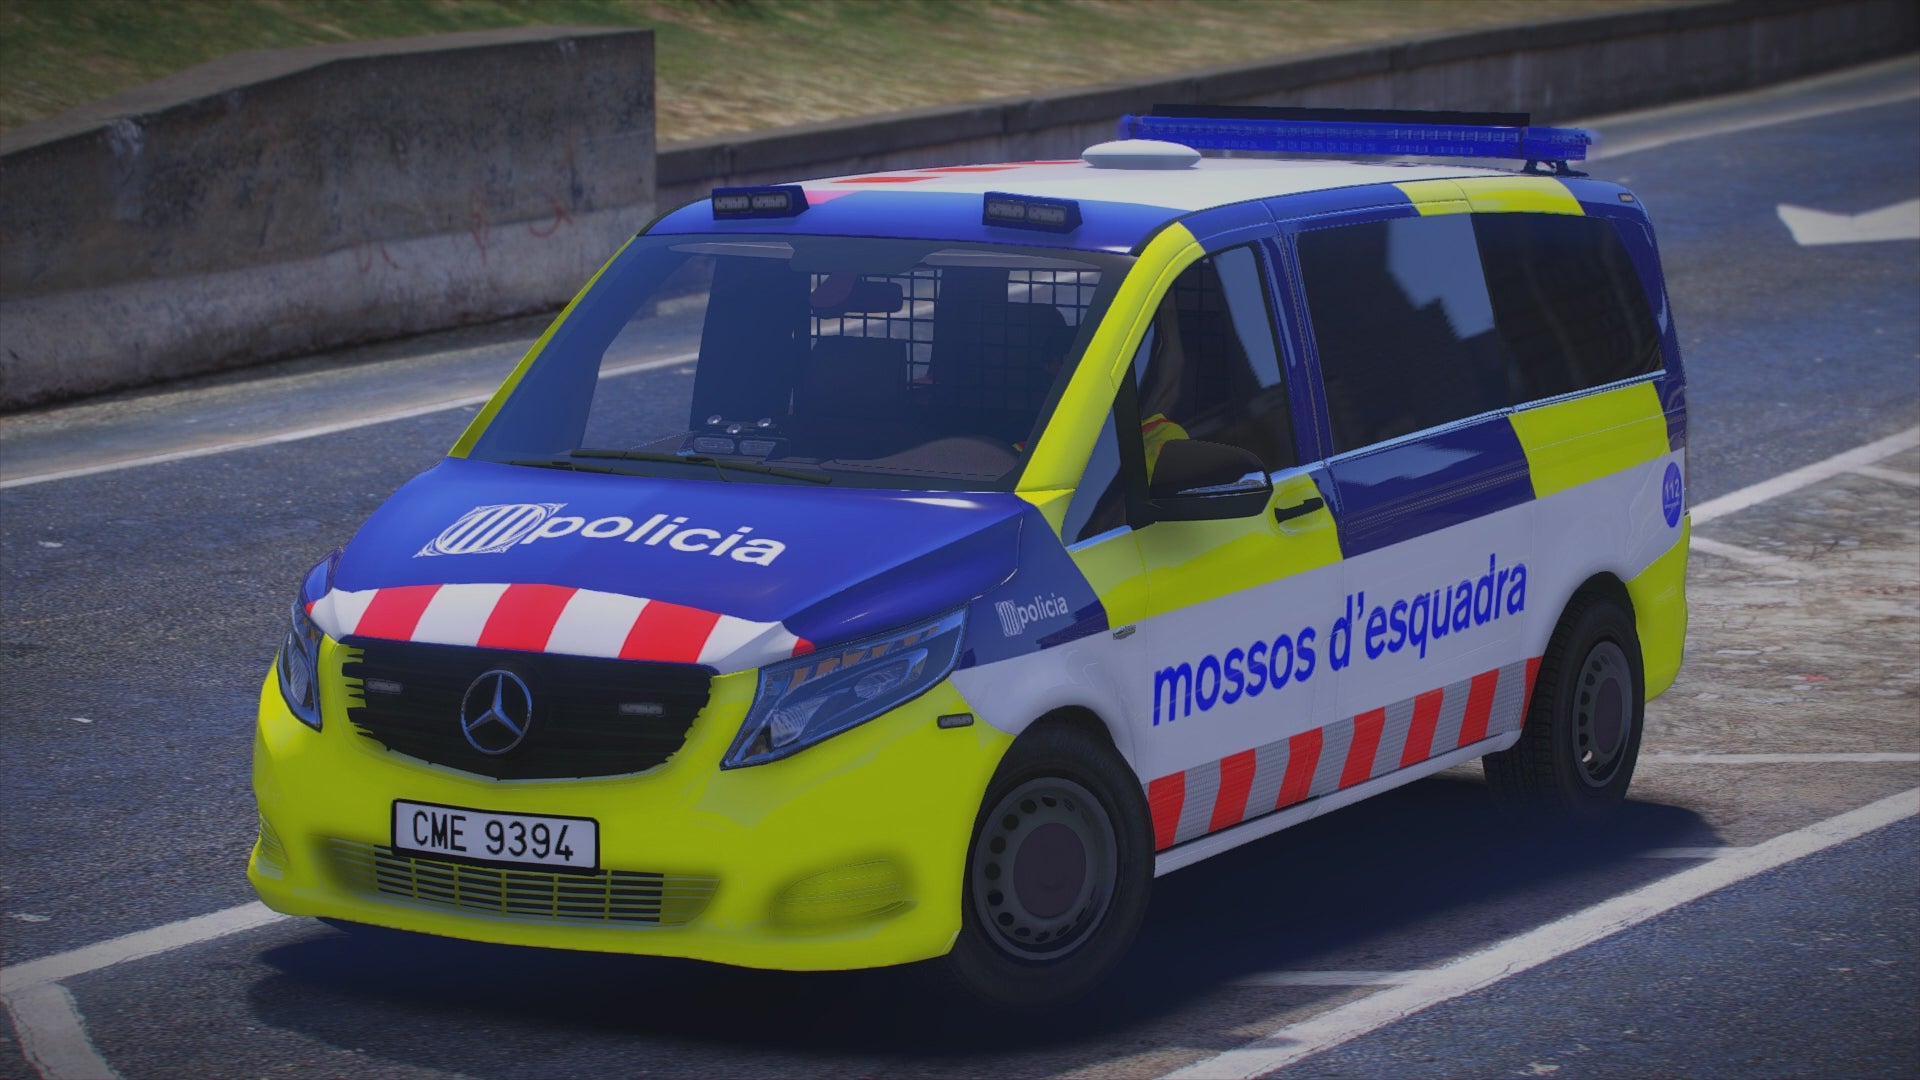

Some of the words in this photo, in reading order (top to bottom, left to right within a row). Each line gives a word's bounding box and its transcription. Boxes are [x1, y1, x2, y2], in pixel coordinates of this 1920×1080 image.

[1664, 477, 1680, 500] 112
[523, 513, 786, 566] policia
[1017, 592, 1069, 629] policia
[1152, 626, 1316, 726] mossos
[1329, 554, 1527, 671] d’esquadra
[413, 811, 467, 852] CME
[485, 820, 573, 861] 9394
